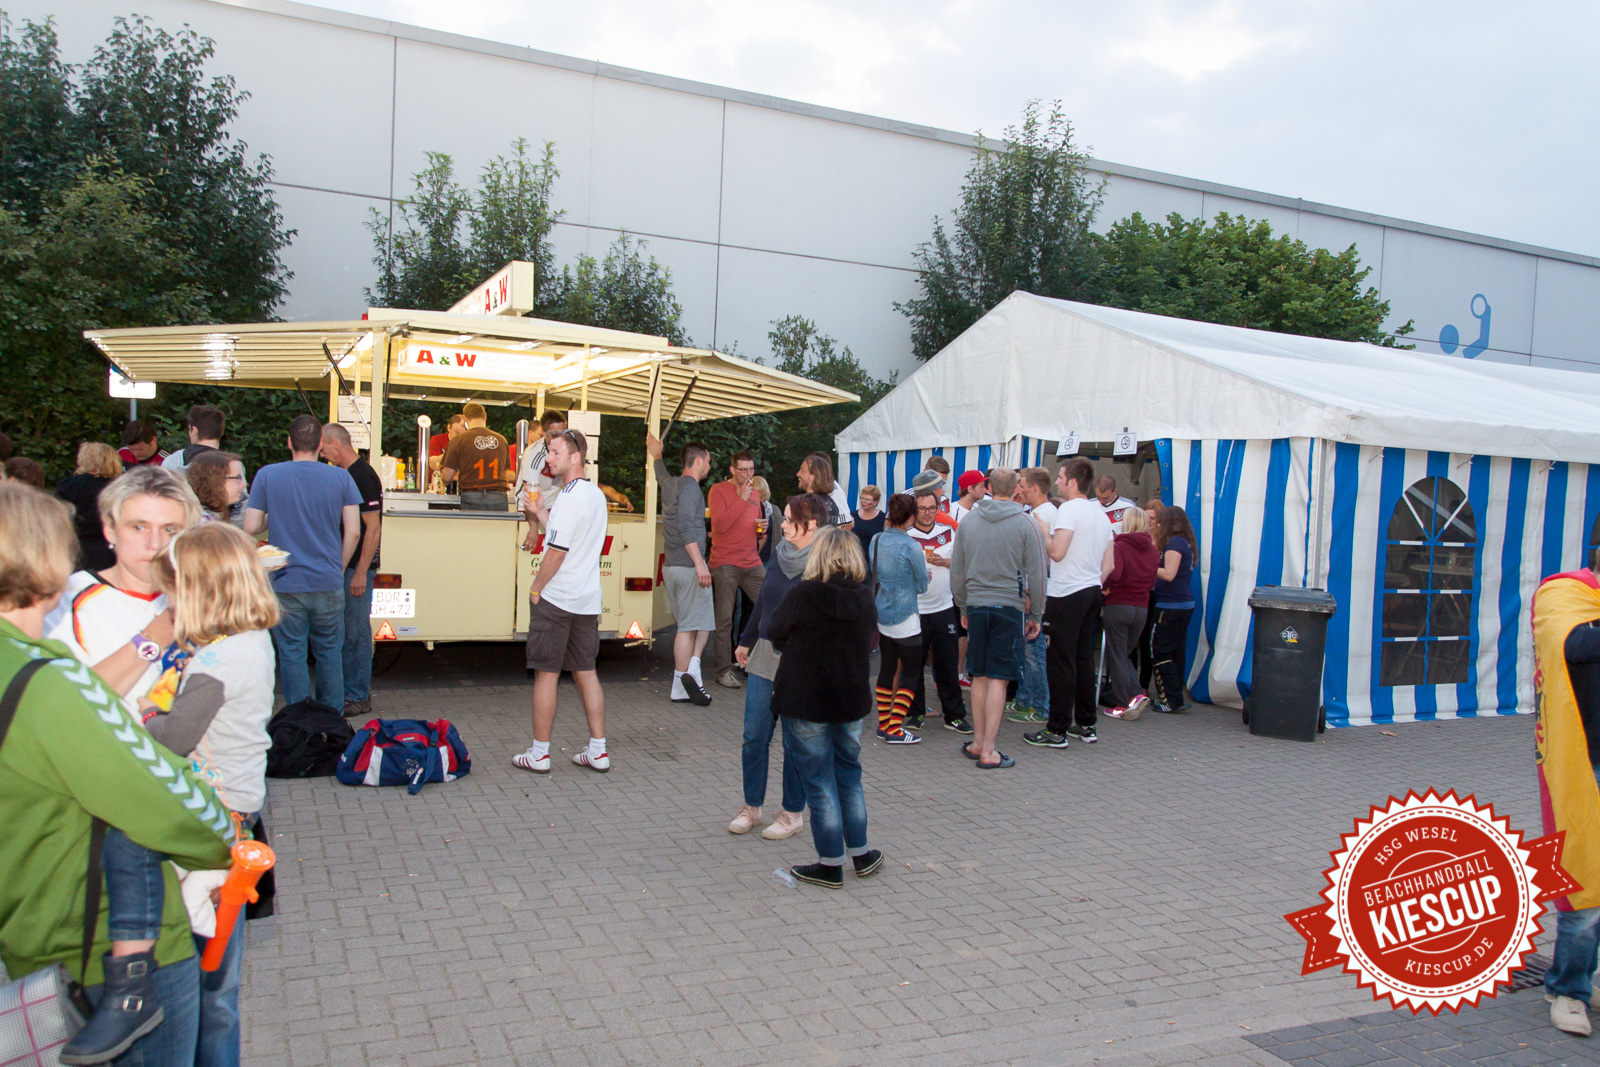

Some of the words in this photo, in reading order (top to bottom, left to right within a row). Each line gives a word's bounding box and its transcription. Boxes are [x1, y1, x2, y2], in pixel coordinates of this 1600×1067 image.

[484, 287, 491, 315] A
[499, 274, 508, 305] W
[416, 350, 434, 365] A
[439, 356, 451, 366] &
[455, 352, 477, 368] W
[473, 458, 499, 480] 11
[376, 591, 400, 603] BOR
